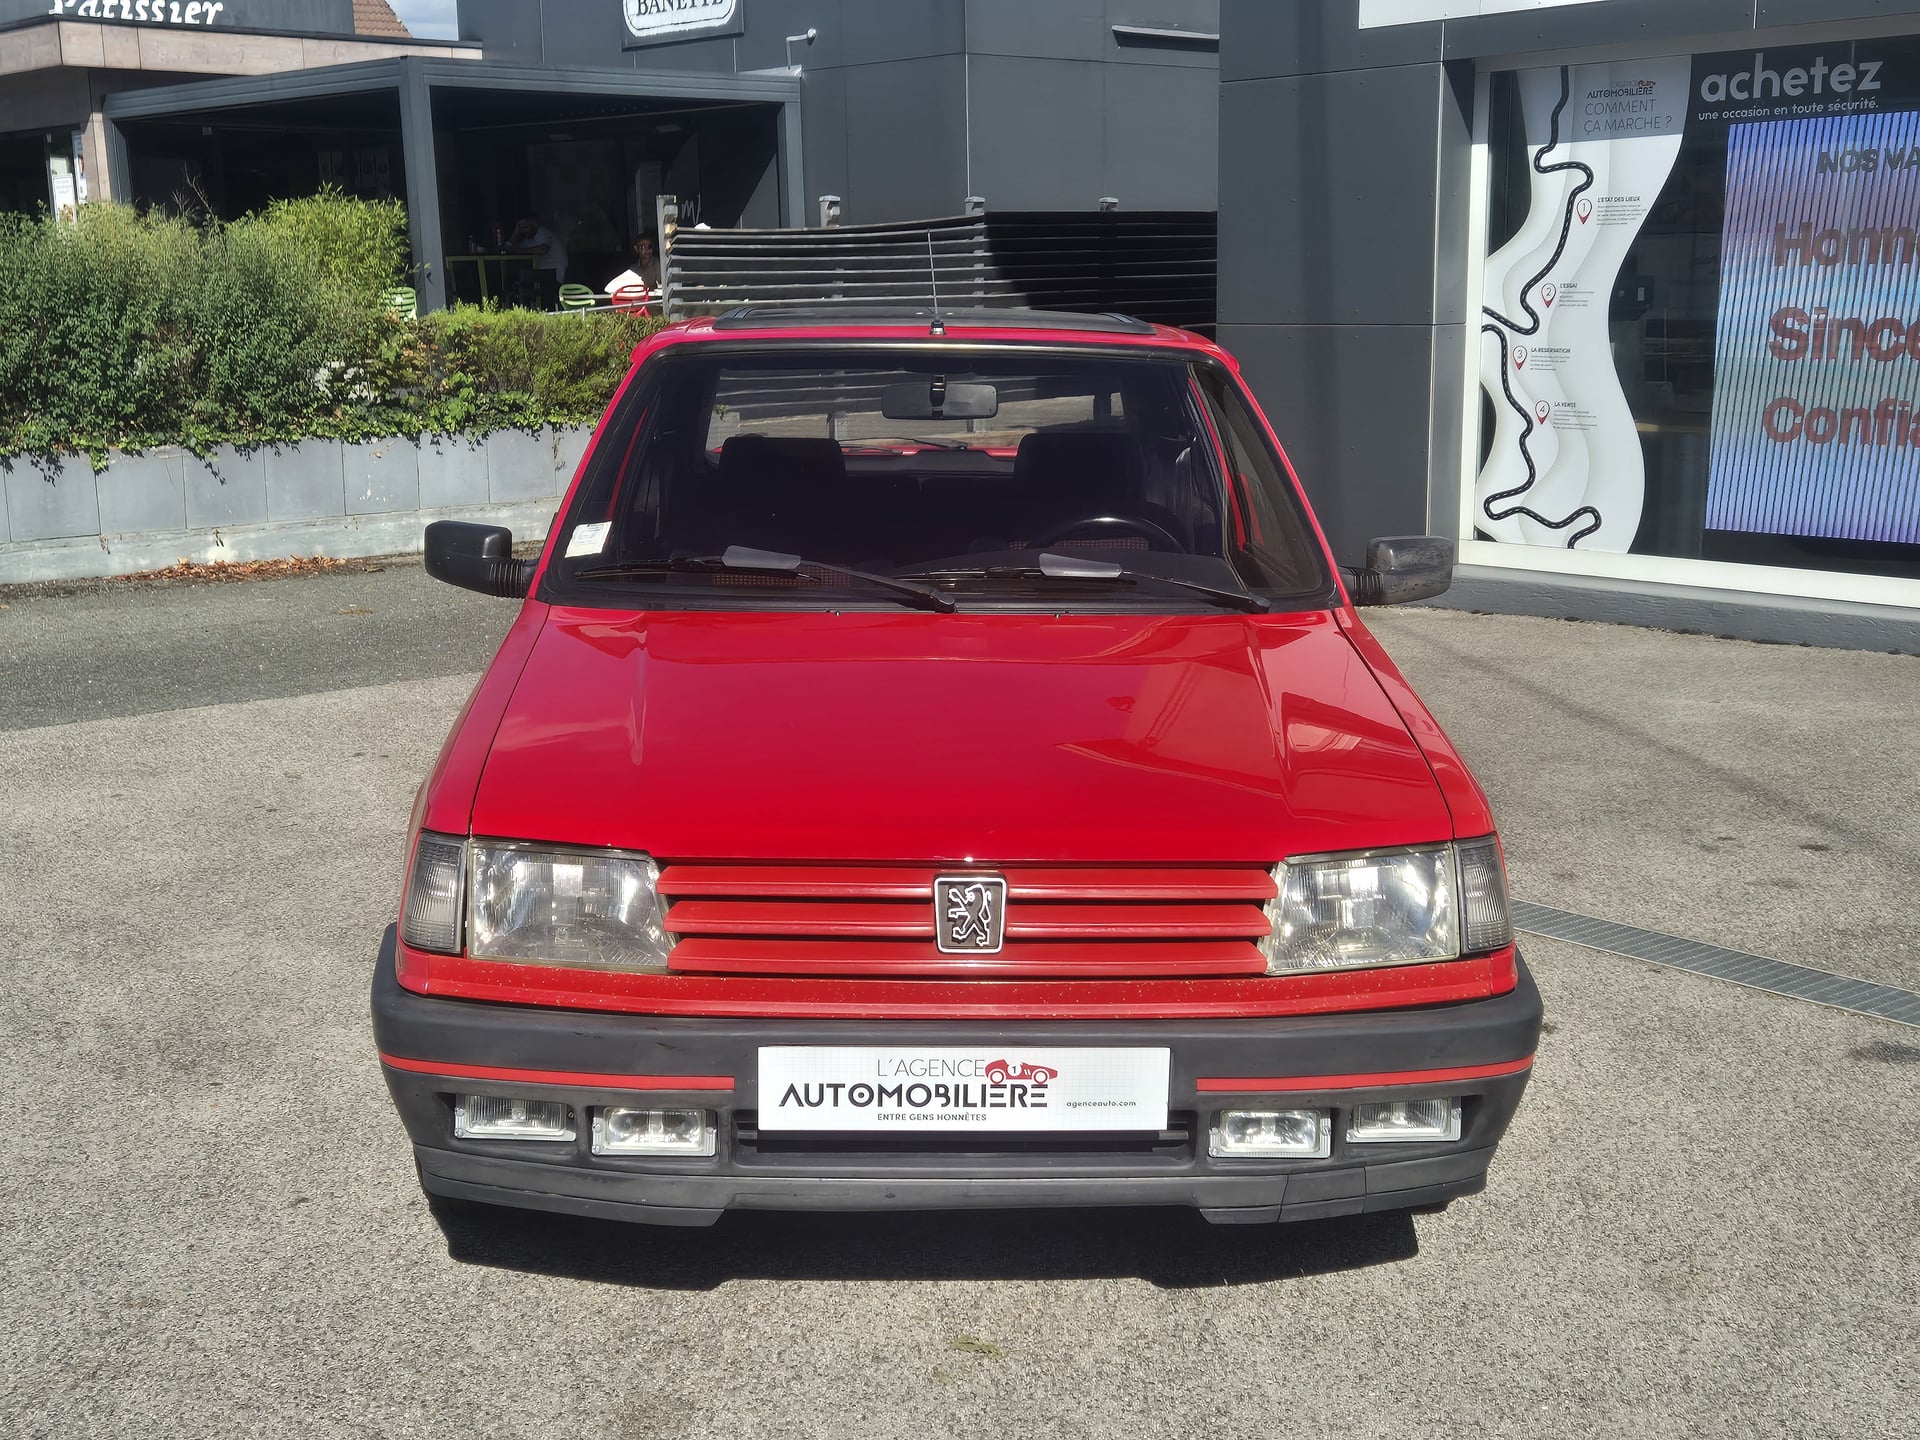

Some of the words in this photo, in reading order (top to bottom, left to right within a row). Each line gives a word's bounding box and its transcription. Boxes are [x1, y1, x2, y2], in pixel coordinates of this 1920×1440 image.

[1700, 52, 1884, 103] achetez
[1584, 98, 1657, 116] COMMENT
[1698, 111, 1719, 121] une
[1722, 105, 1770, 118] occasion
[1774, 106, 1788, 115] en
[1792, 103, 1824, 114] toute
[1828, 96, 1879, 111] sécurité.
[1583, 119, 1601, 136] ÇA
[1604, 116, 1661, 133] MARCHE
[1773, 220, 1920, 267] Honn
[1545, 287, 1552, 297] 2
[1517, 349, 1523, 359] 3
[877, 1059, 985, 1077] L'AGENCE
[1066, 1098, 1137, 1107] agenceauto.com
[877, 1113, 906, 1121] ENTRE
[909, 1113, 934, 1121] GENS
